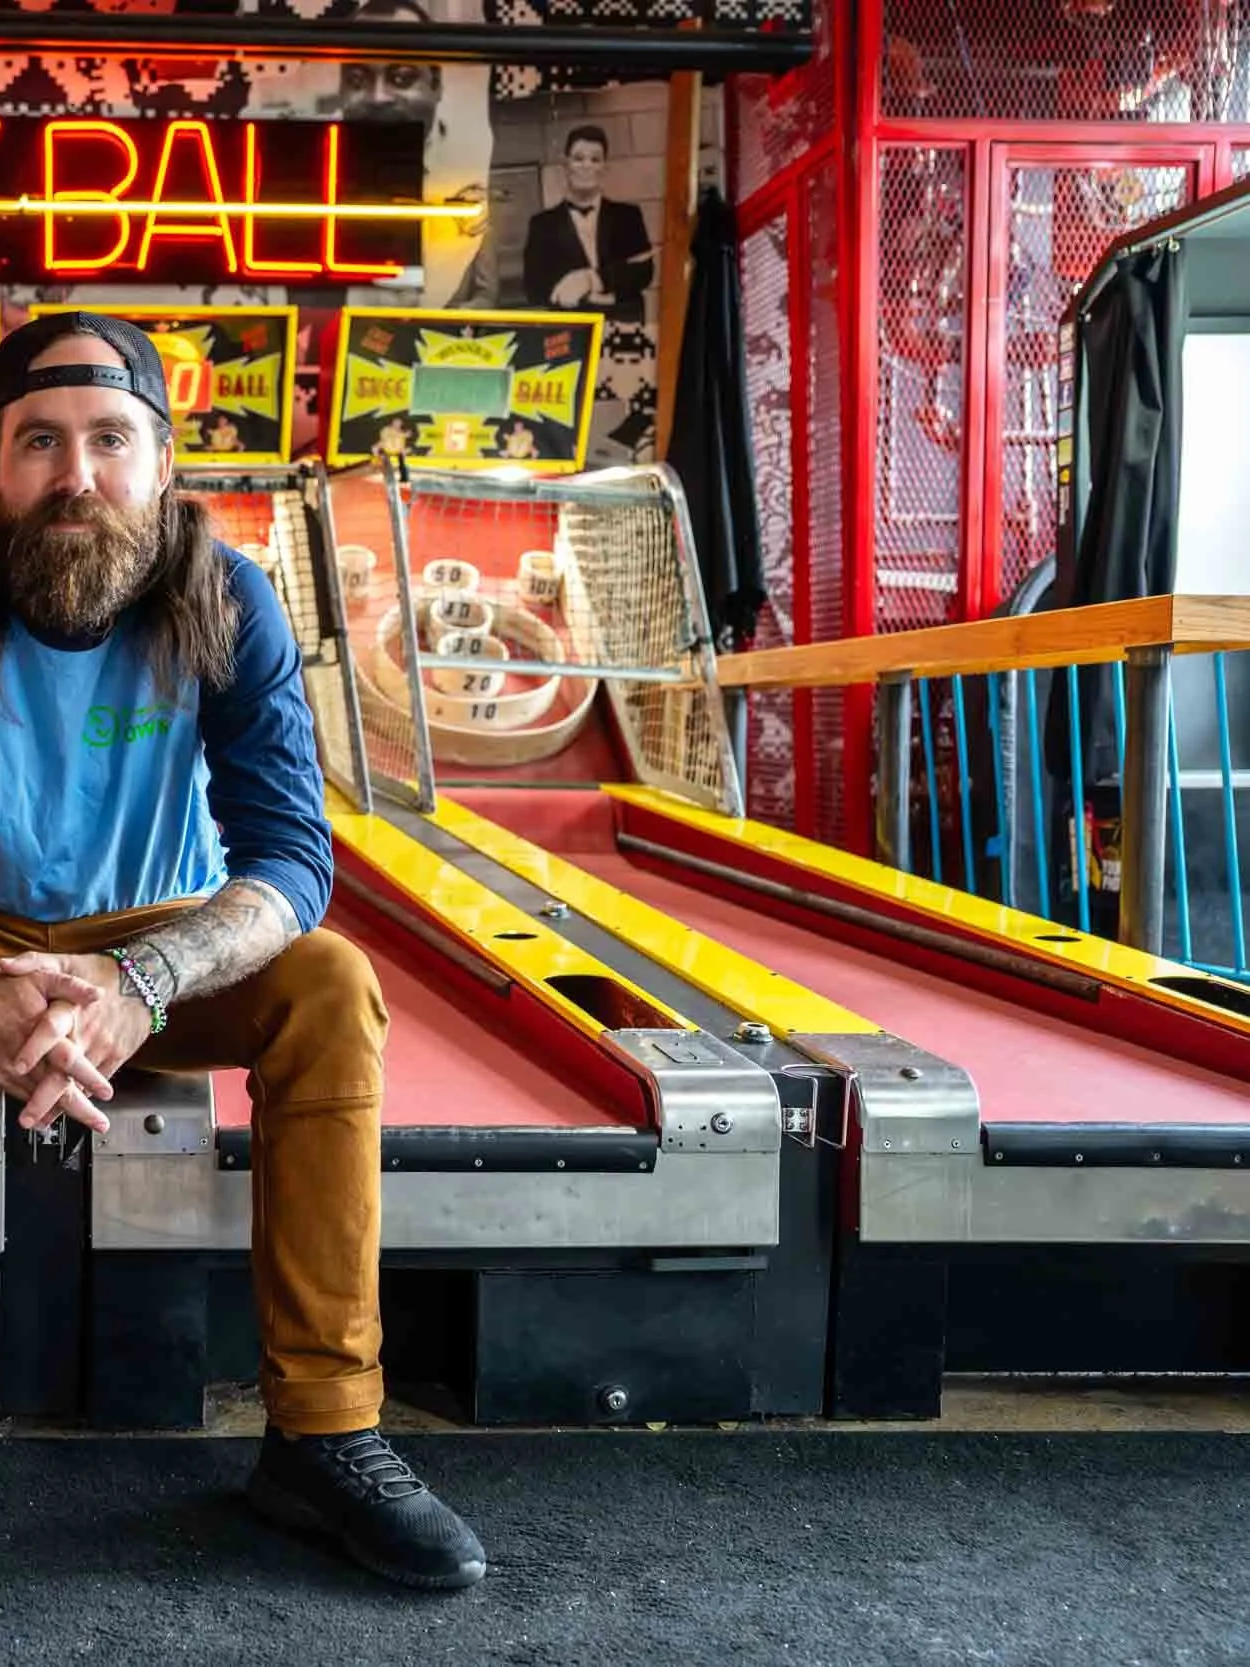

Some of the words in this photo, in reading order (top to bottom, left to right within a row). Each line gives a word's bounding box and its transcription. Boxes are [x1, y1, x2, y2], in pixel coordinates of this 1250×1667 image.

[43, 119, 407, 278] BALL
[217, 373, 269, 399] BALL
[515, 381, 567, 405] BALL
[434, 567, 462, 583] 50
[444, 603, 471, 620] 40
[462, 674, 492, 692] 20
[471, 703, 497, 720] 10
